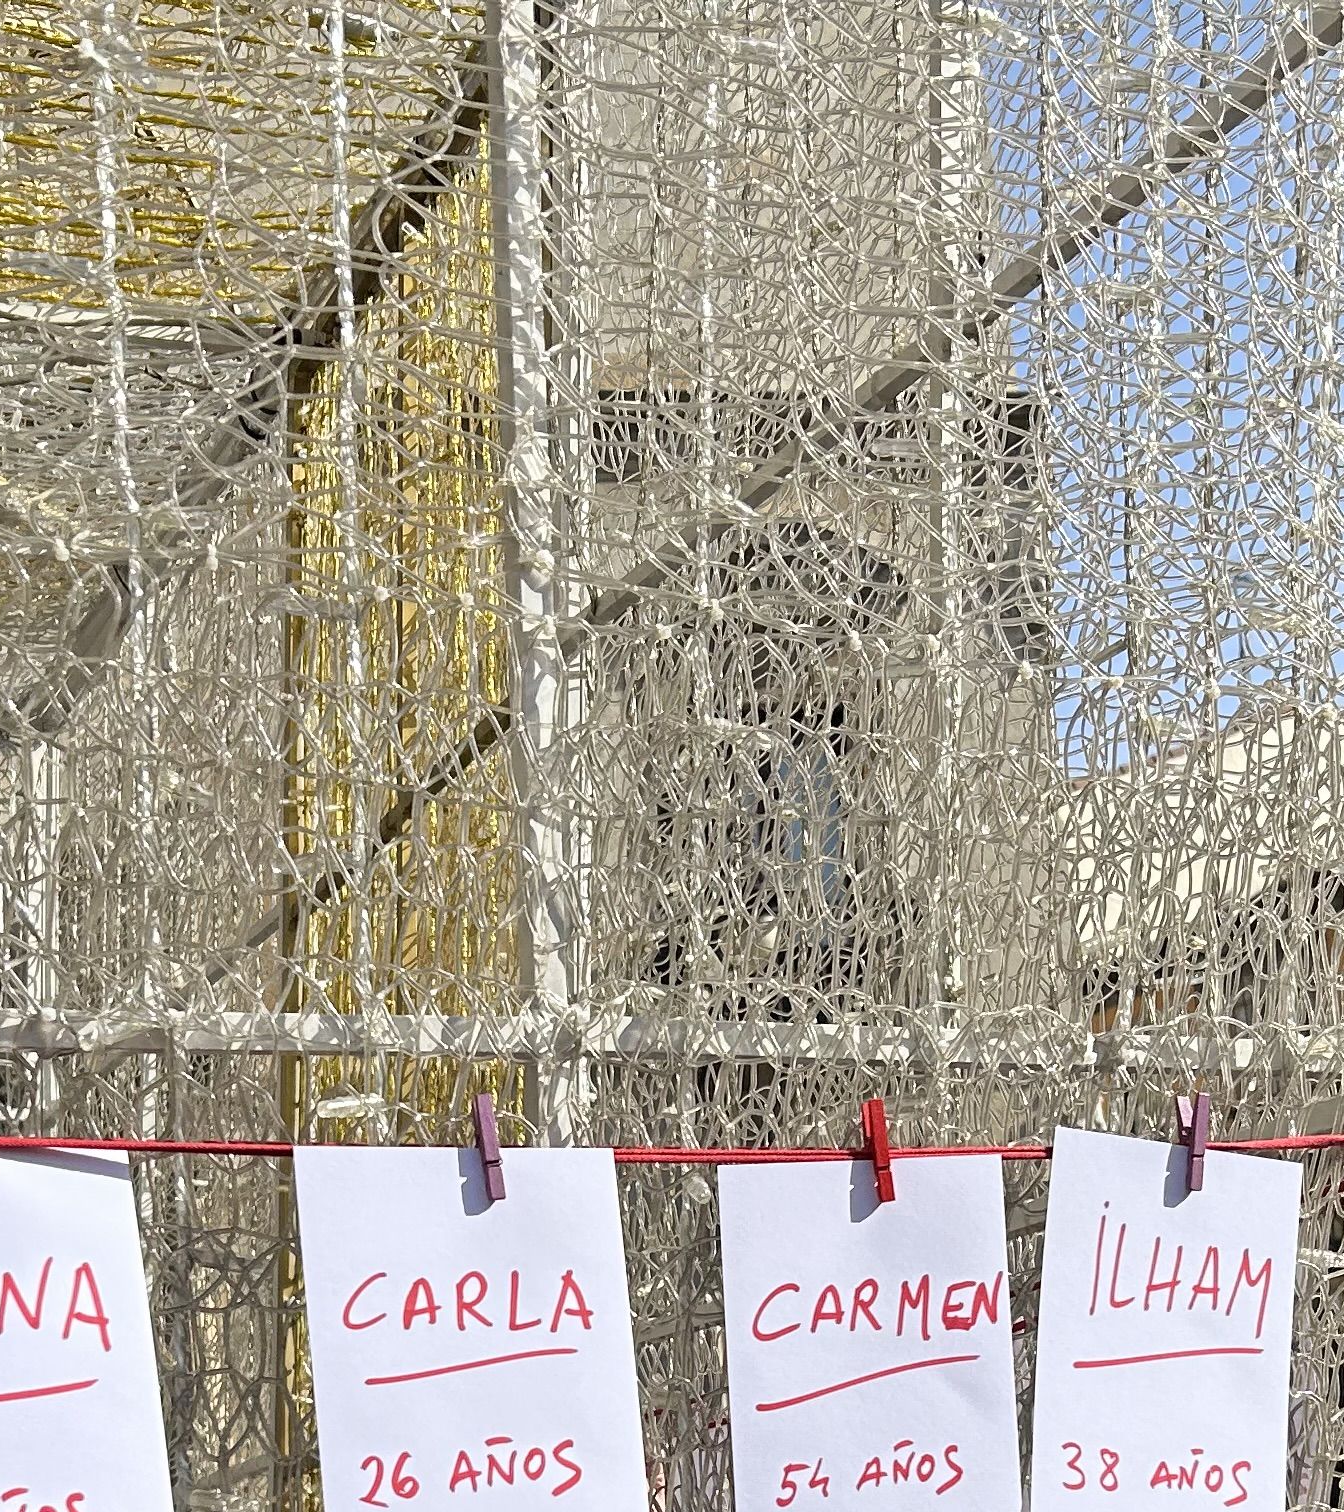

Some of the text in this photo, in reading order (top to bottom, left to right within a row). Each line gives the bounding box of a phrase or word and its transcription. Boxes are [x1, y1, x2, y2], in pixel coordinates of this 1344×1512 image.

[342, 1269, 594, 1333] CARLA
[752, 1271, 1003, 1342] CARMEN
[360, 1436, 583, 1507] 26 AÑOS
[776, 1439, 965, 1508] 54 AÑOS
[1062, 1442, 1252, 1508] 38 AÑOS
